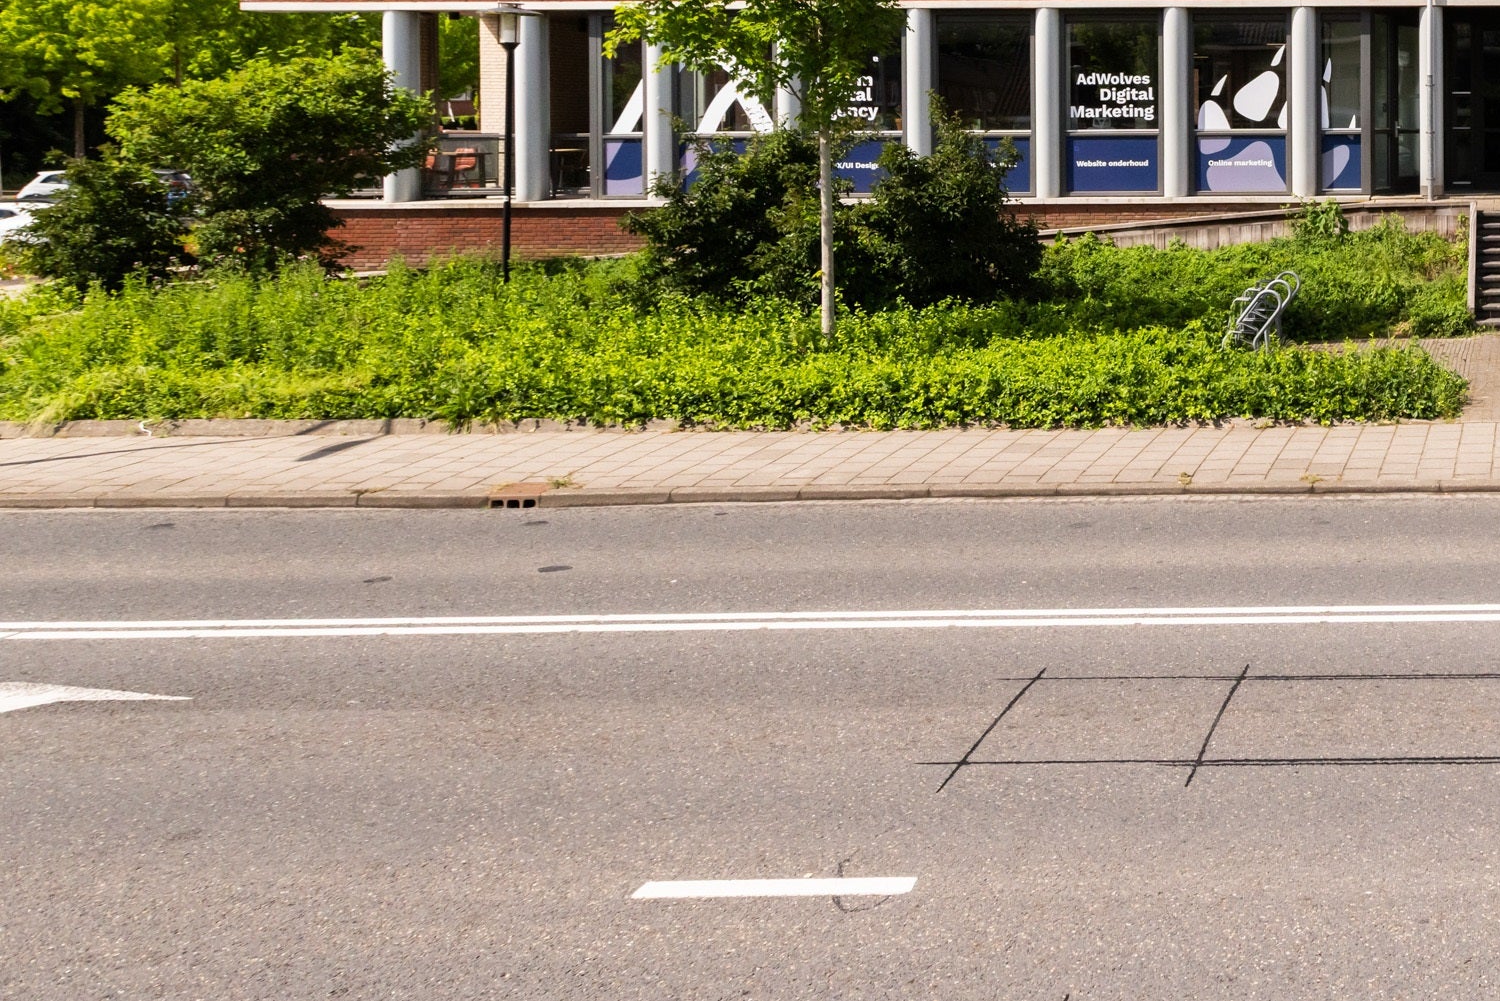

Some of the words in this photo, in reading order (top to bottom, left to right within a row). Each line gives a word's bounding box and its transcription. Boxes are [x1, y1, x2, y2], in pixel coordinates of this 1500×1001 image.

[1076, 72, 1151, 86] AdWolves
[1099, 87, 1155, 105] Digital
[1070, 104, 1155, 121] Marketing
[1076, 159, 1107, 168] Website
[1108, 159, 1150, 167] onderhoud
[1208, 159, 1233, 167] Online
[1234, 159, 1272, 168] marketing
